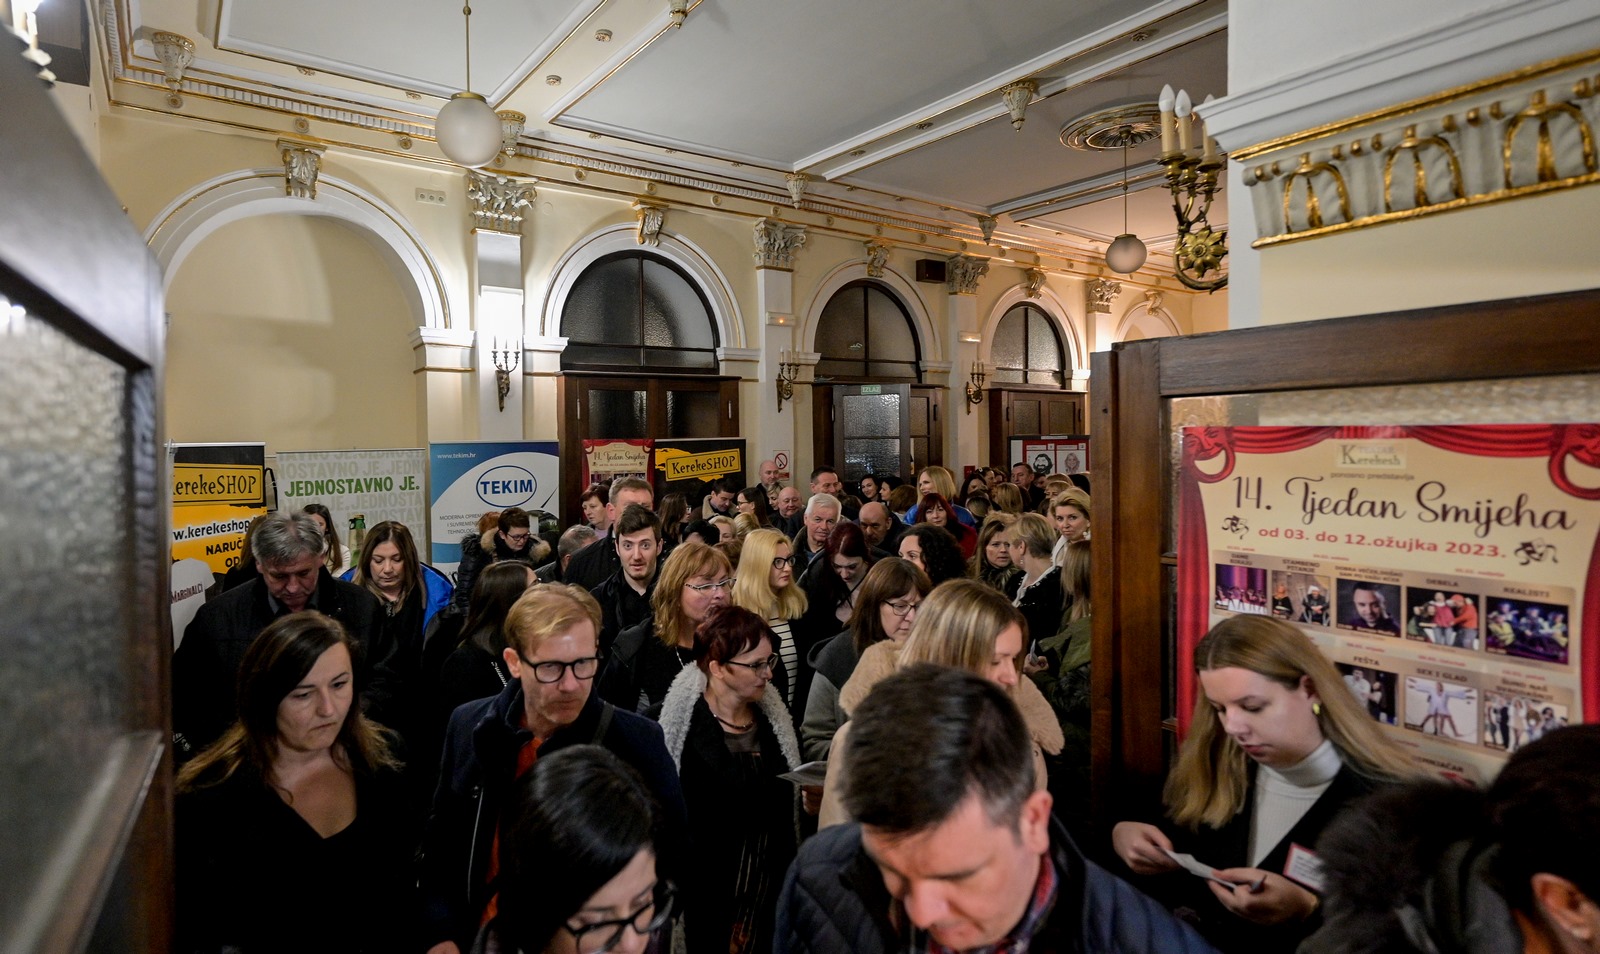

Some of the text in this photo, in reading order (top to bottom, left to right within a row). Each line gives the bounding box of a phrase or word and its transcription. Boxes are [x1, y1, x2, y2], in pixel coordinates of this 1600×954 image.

[672, 455, 736, 475] KerekeSHOP
[173, 473, 257, 496] erekeSHOP
[284, 475, 420, 497] JEDNOSTAVNO JE.
[480, 479, 533, 495] TEKIM
[1232, 475, 1578, 539] 14. Tjedan Smijeha
[206, 537, 243, 555] NARUČ
[1258, 526, 1507, 559] od 03. do 12.ožujka 2023.
[1282, 559, 1320, 568] STAMBENO
[1286, 565, 1315, 573] PITANJE
[1425, 578, 1459, 588] DEBELA
[1503, 586, 1550, 598] REALISTI
[1353, 655, 1380, 667] FEŠTA
[1416, 667, 1433, 677] SEX
[1442, 671, 1468, 683] GLAD
